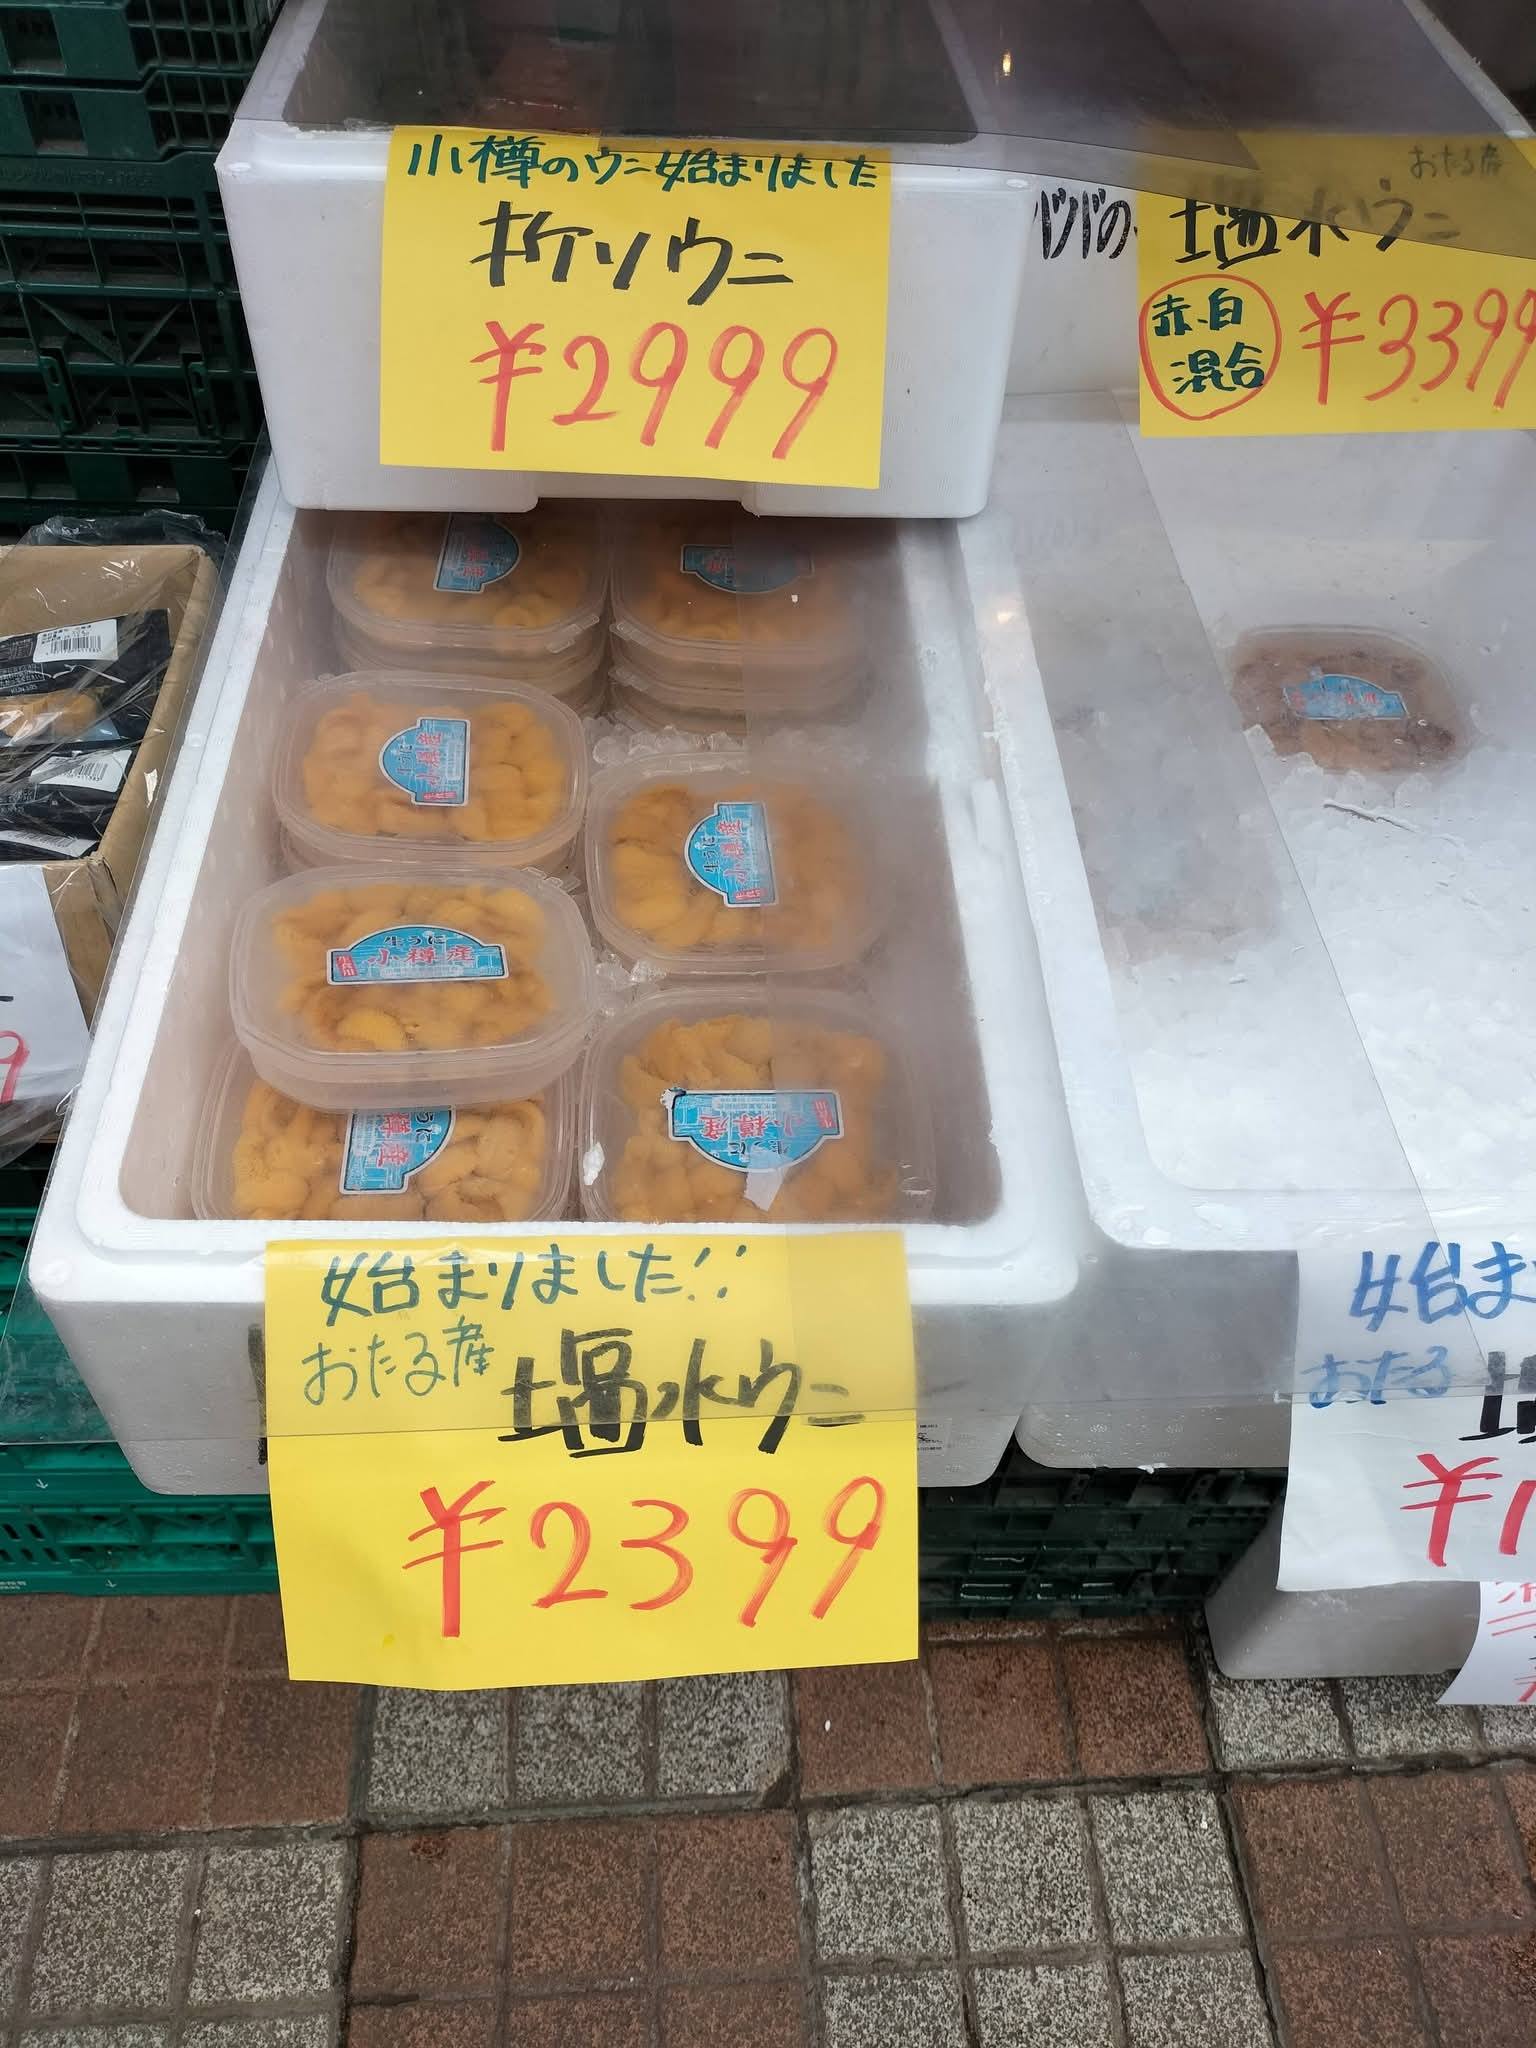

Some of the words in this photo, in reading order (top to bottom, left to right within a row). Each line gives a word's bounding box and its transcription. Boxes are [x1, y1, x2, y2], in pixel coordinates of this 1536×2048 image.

[407, 134, 877, 196] 小樽のウニ始まりました
[470, 321, 838, 459] ¥2999
[1300, 288, 1536, 409] ¥3399
[368, 944, 476, 968] 小樽産
[402, 1476, 886, 1637] ¥2399
